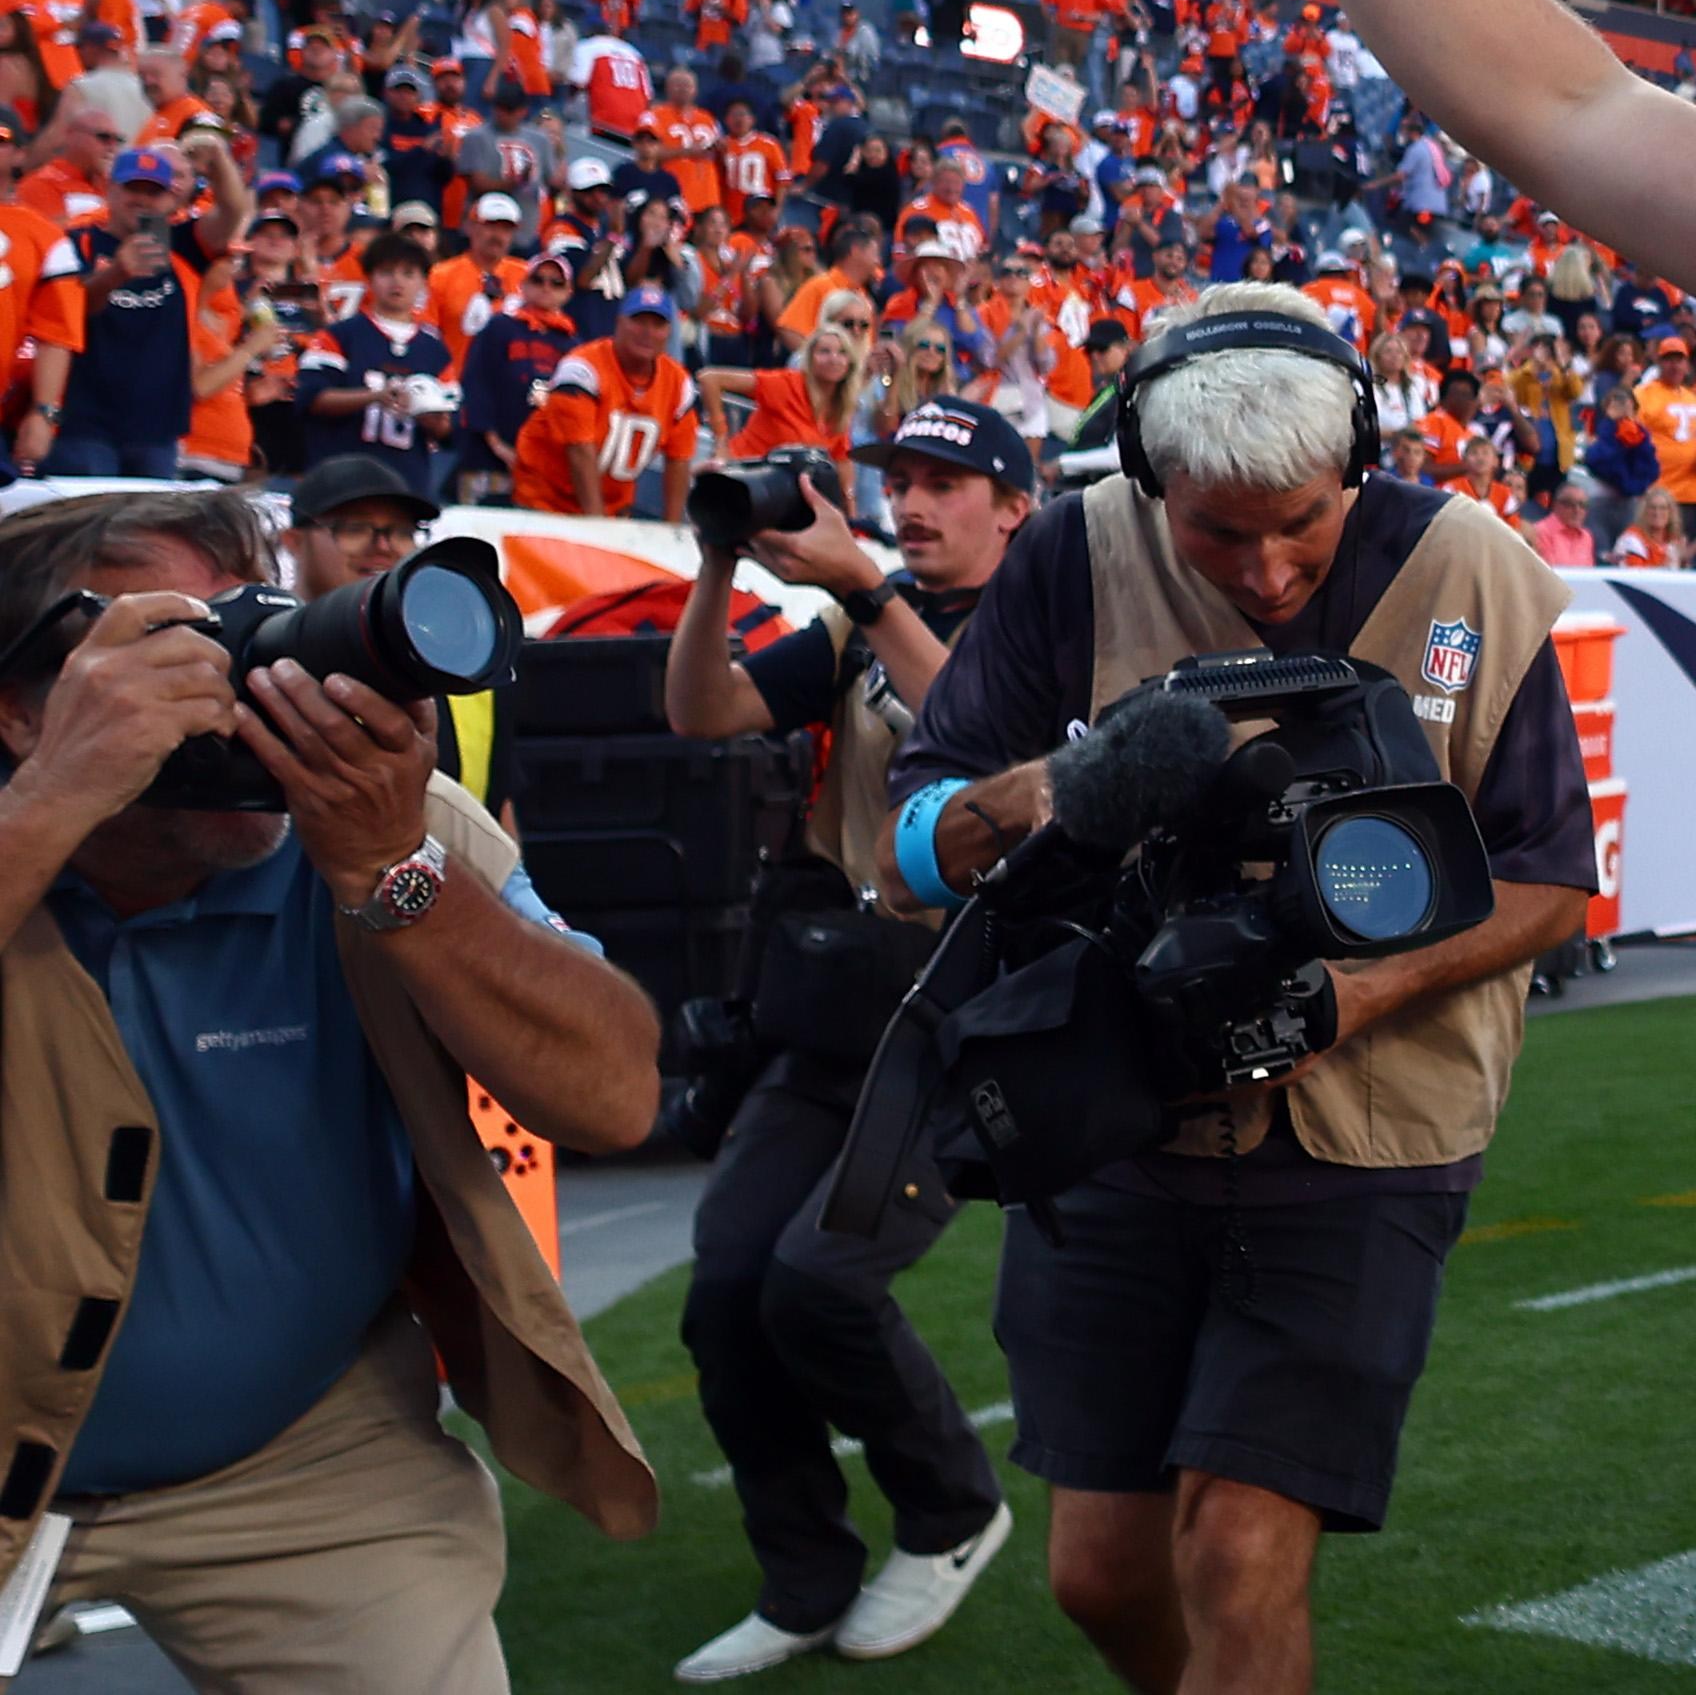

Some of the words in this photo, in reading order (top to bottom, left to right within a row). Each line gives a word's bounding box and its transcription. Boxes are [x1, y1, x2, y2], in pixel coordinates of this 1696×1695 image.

[724, 150, 767, 195] 10
[596, 408, 662, 481] 10
[1428, 646, 1470, 683] NFL
